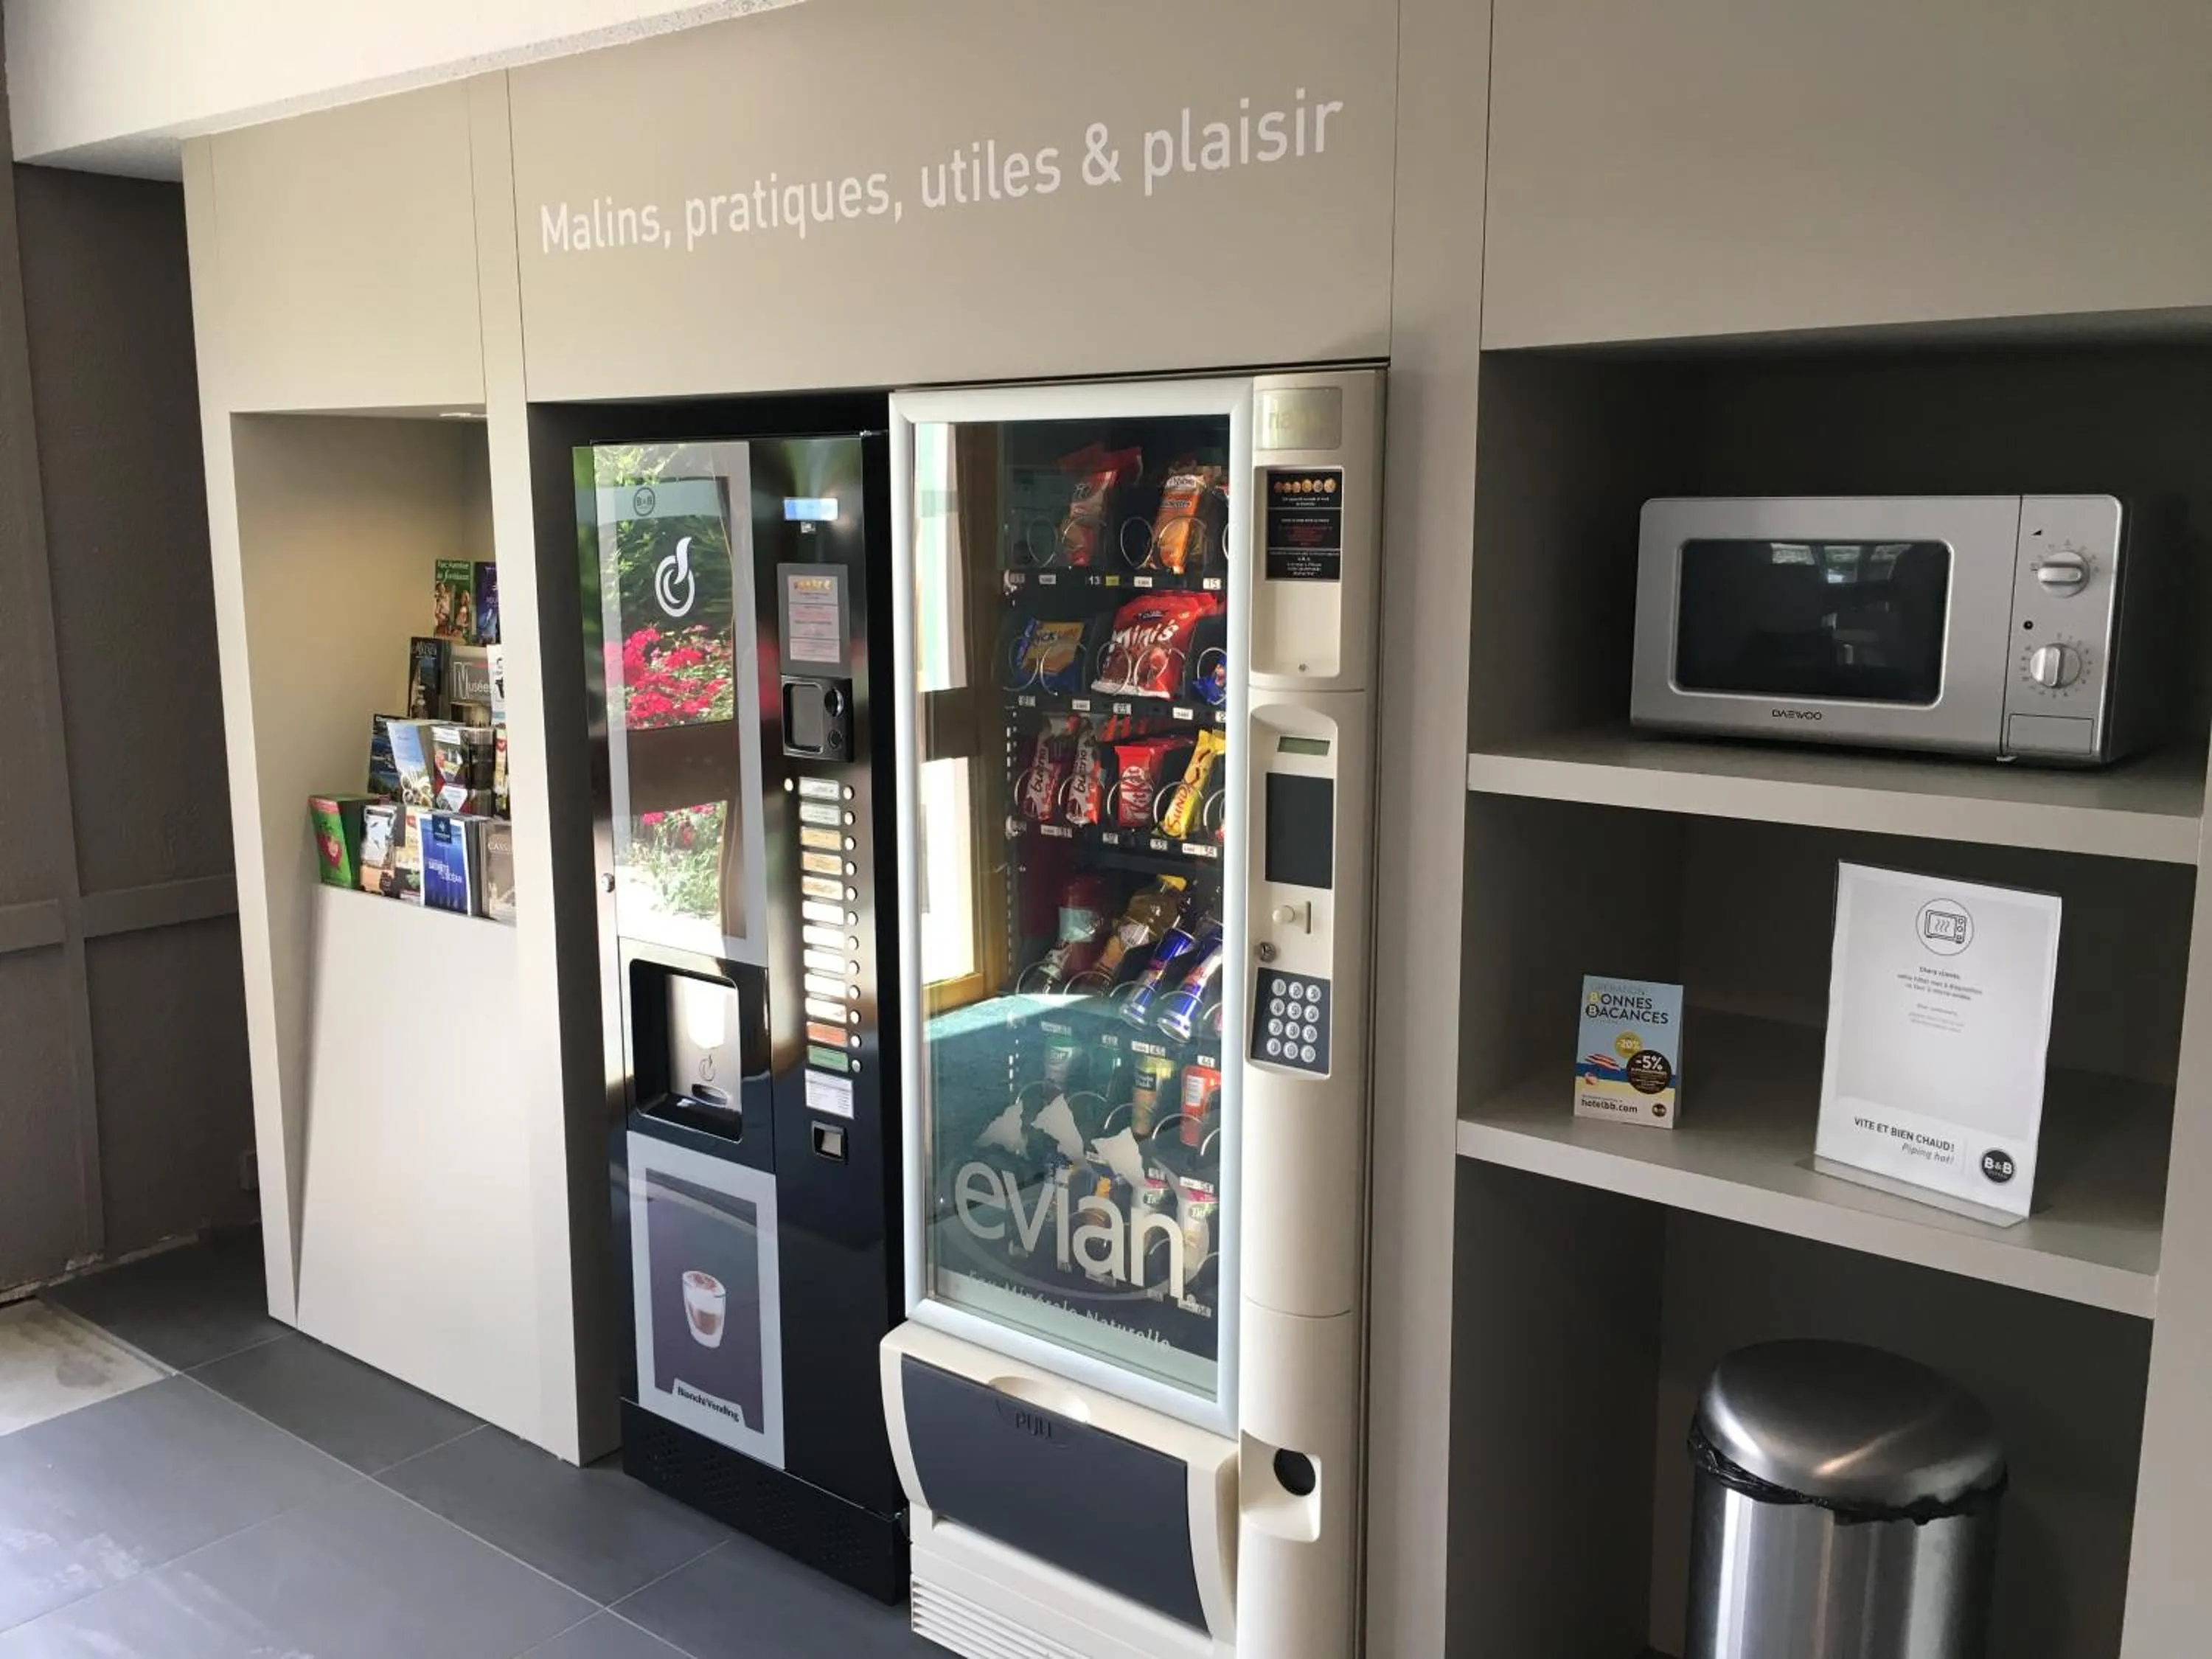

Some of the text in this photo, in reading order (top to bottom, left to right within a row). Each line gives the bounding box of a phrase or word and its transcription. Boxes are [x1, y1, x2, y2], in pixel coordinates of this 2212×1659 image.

[540, 87, 1343, 254] Malins, pratiques, utiles & plaisir
[1771, 709, 1823, 720] DAEWOO
[1635, 1055, 1663, 1071] -5%
[1581, 1099, 1638, 1113] hotelbb.com
[1854, 1116, 1874, 1130] VITE
[1877, 1123, 1888, 1133] ET
[1891, 1126, 1914, 1141] BIEN
[1902, 1142, 1931, 1160] Piping
[1984, 1157, 2012, 1175] B&B
[955, 1161, 1184, 1302] evian
